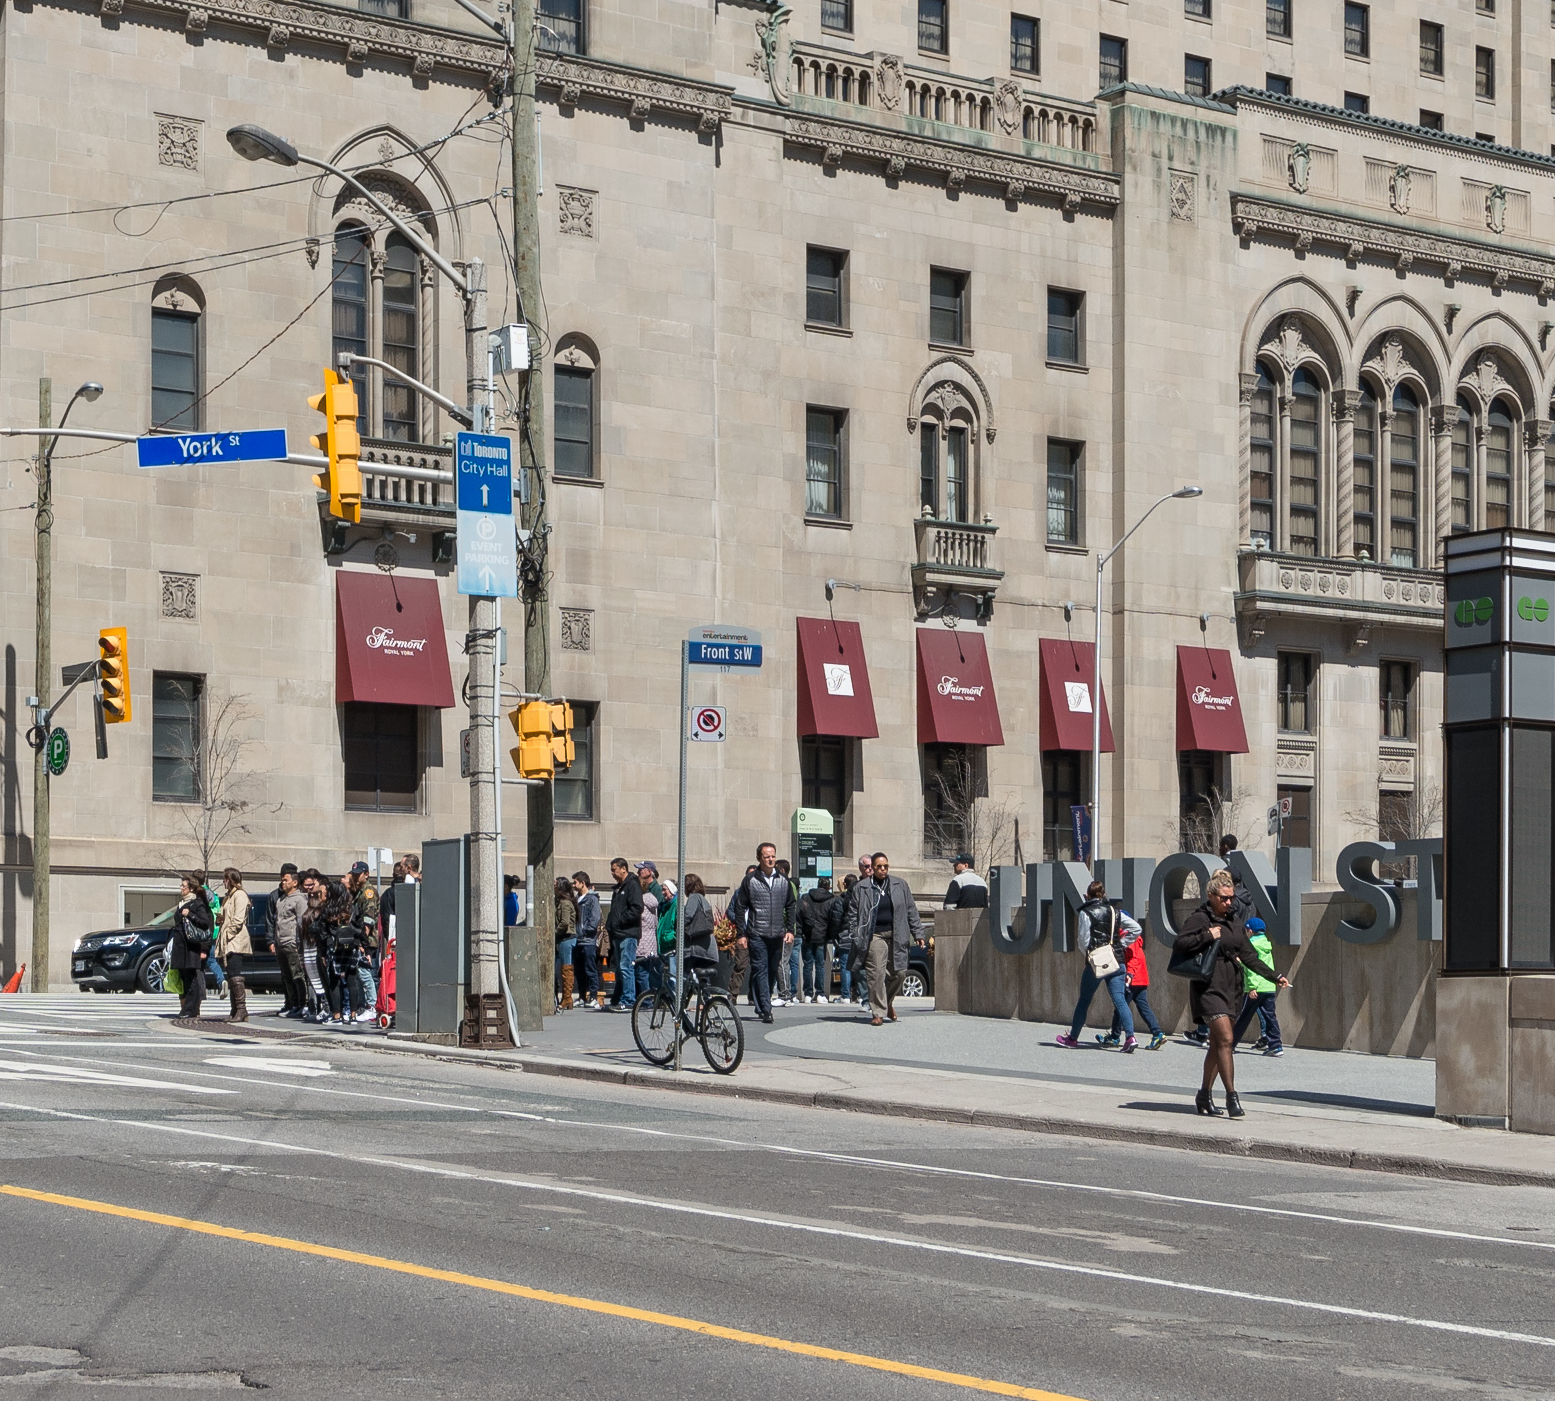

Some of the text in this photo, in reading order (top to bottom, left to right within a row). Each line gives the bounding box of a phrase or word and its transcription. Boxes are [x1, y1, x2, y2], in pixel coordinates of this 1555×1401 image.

[177, 435, 240, 458] York St
[473, 442, 508, 460] TORONTO
[461, 460, 508, 477] City Hall
[471, 541, 502, 552] EVENT
[465, 552, 509, 565] PARKING
[366, 626, 427, 652] Fairmont
[702, 633, 748, 641] entertainment
[384, 648, 400, 656] ROYAL
[701, 644, 752, 660] Front St W
[720, 665, 731, 673] 117
[937, 675, 985, 697] Fairmont
[1192, 685, 1234, 706] Fairmont
[989, 847, 1312, 954] UNION
